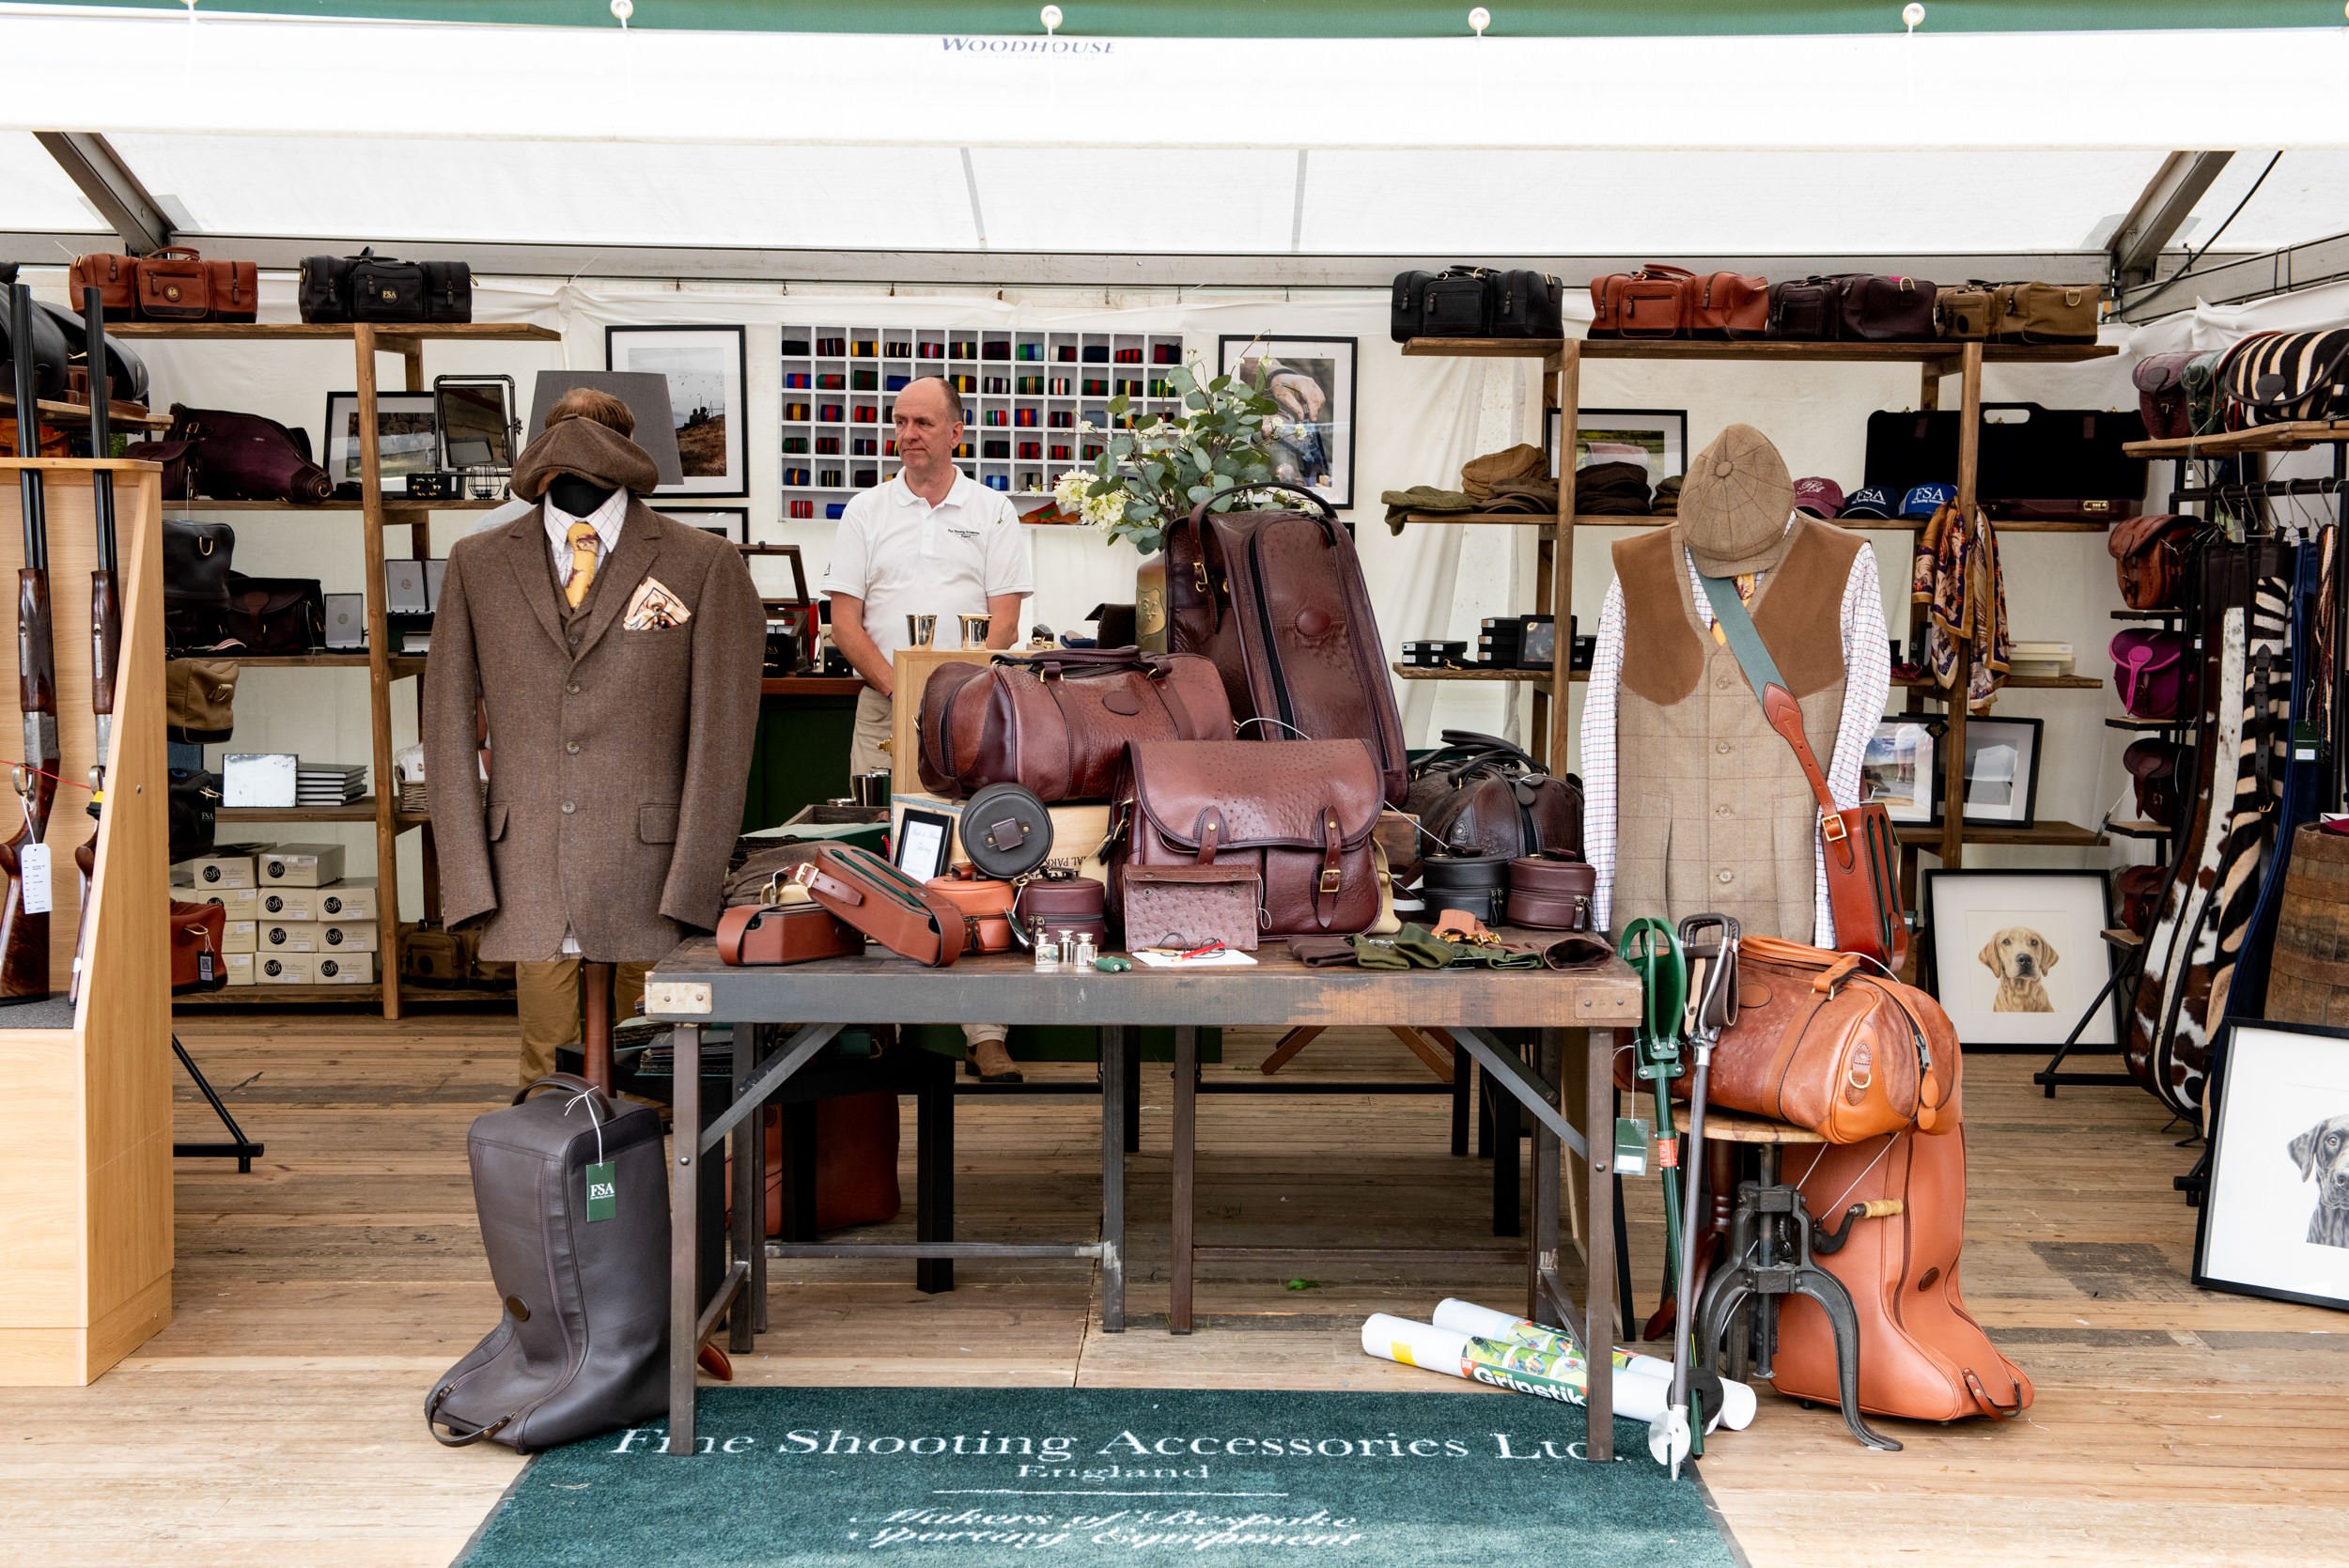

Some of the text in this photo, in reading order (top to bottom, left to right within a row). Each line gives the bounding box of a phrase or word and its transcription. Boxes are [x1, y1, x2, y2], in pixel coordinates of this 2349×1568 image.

[382, 290, 397, 299] FSA
[1856, 489, 1886, 501] FSA
[1913, 487, 1945, 501] FSA
[201, 812, 214, 820] FSA
[590, 1182, 615, 1197] FSA
[1473, 1366, 1587, 1408] Gripstik
[779, 1429, 1078, 1462] Shooting
[1098, 1430, 1469, 1457] Accessories
[1019, 1464, 1209, 1483] England
